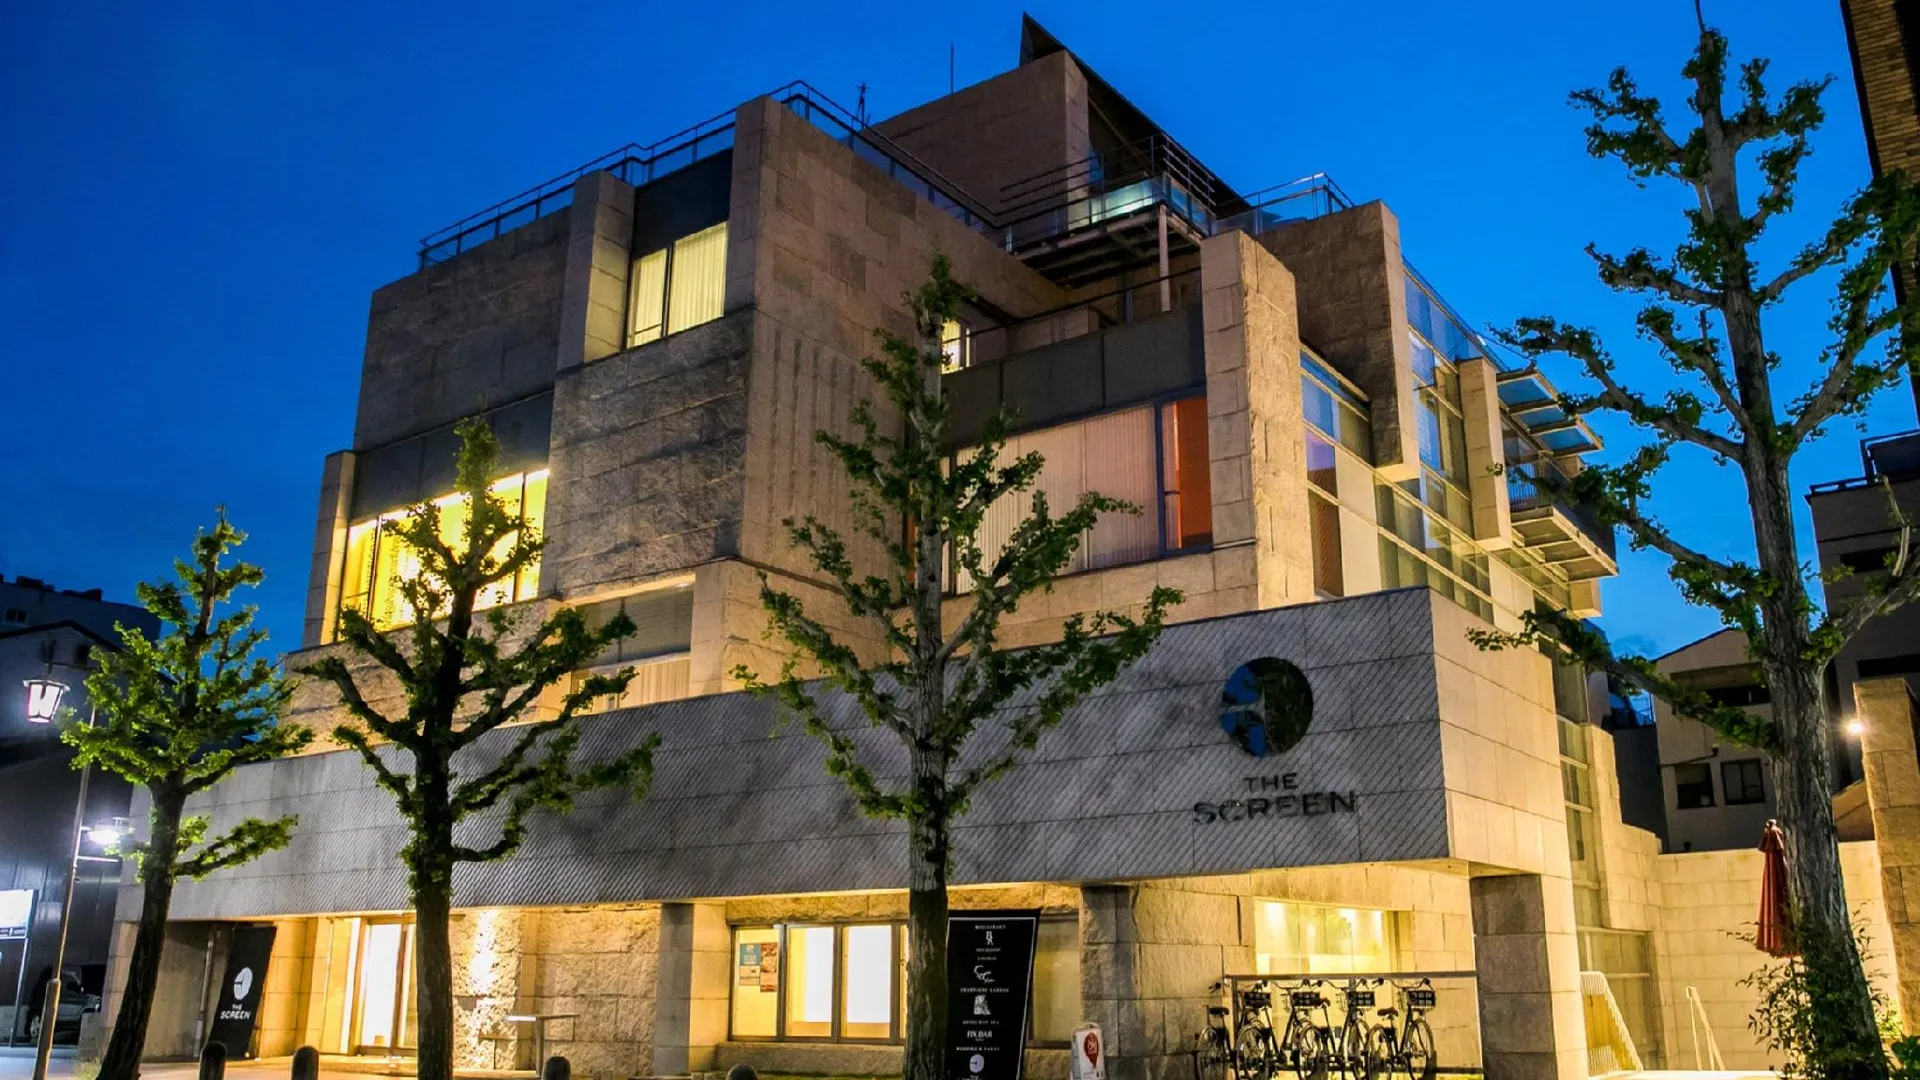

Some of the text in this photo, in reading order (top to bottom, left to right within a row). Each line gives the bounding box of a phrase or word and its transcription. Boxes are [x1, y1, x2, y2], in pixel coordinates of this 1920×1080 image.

[1243, 772, 1299, 792] THE
[1193, 790, 1356, 825] SCREEN
[220, 1011, 251, 1019] SCREEN
